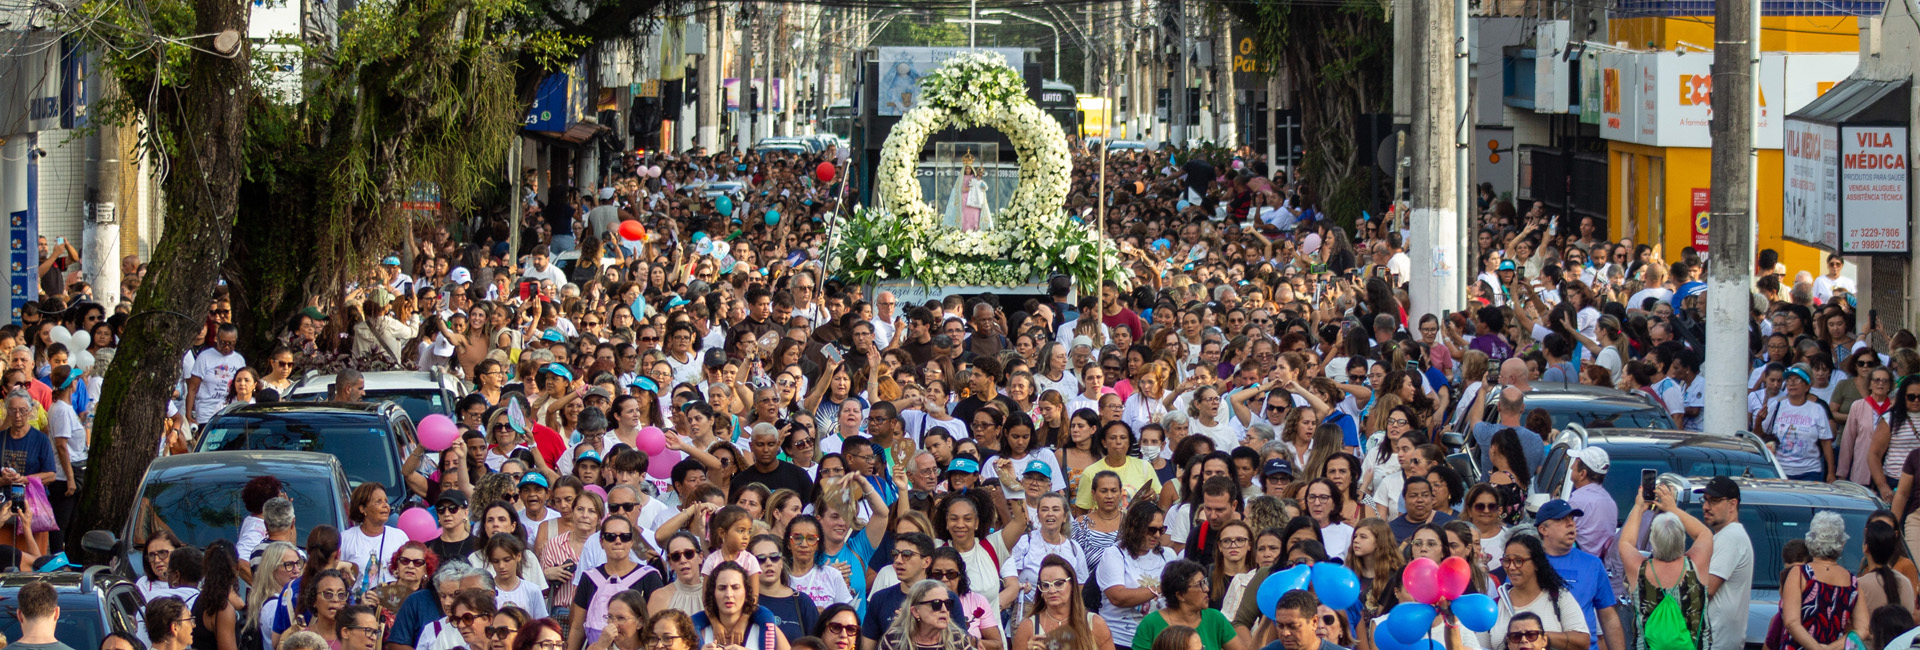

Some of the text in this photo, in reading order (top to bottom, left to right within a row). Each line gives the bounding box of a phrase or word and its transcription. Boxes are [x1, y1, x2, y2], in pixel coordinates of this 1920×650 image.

[1786, 129, 1800, 158] VILA
[1856, 132, 1893, 148] VILA
[1844, 150, 1905, 169] MÉDICA
[1887, 172, 1905, 181] SAÚDE
[1872, 184, 1896, 192] ALUGUEL
[1897, 184, 1901, 192] E
[1846, 192, 1880, 201] ASSISTÊNCIA
[1881, 193, 1903, 201] TÉCNICA
[1850, 228, 1900, 237] 27 3229-7806
[1851, 240, 1905, 249] 27 99807-7521
